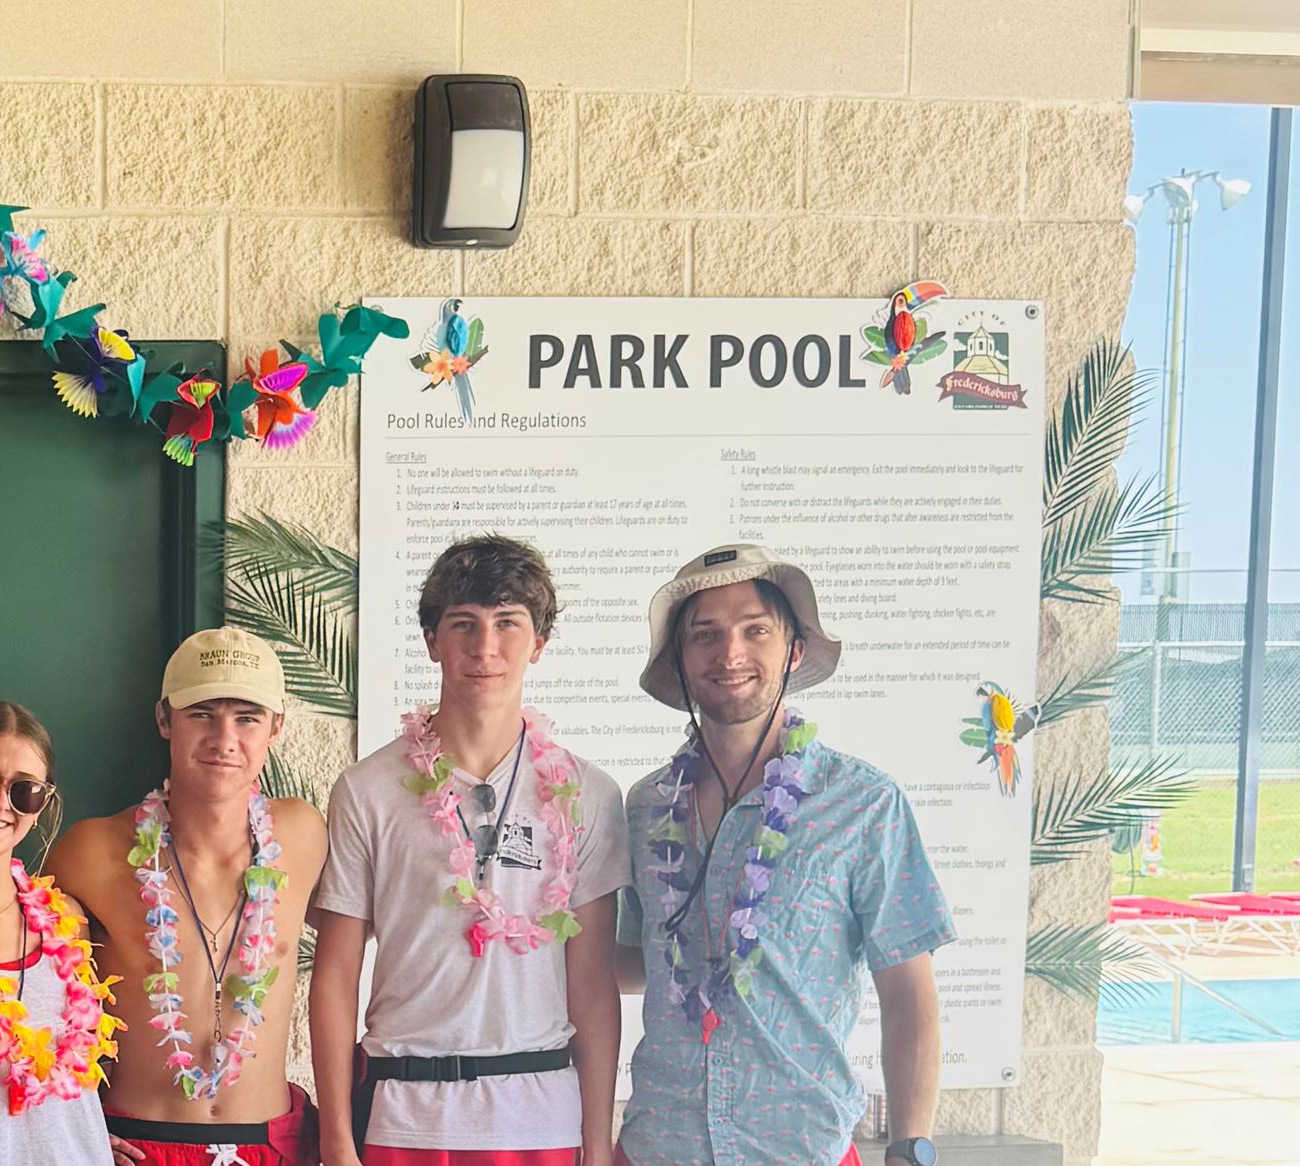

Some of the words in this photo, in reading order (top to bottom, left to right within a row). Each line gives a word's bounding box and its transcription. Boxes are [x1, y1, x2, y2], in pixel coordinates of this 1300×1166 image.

[528, 334, 690, 389] PARK
[709, 334, 867, 389] POOL
[945, 375, 1019, 402] Fredericksburg
[387, 412, 420, 429] Pool
[424, 412, 464, 429] Rules
[471, 412, 496, 429] nd
[501, 412, 587, 432] Regulations
